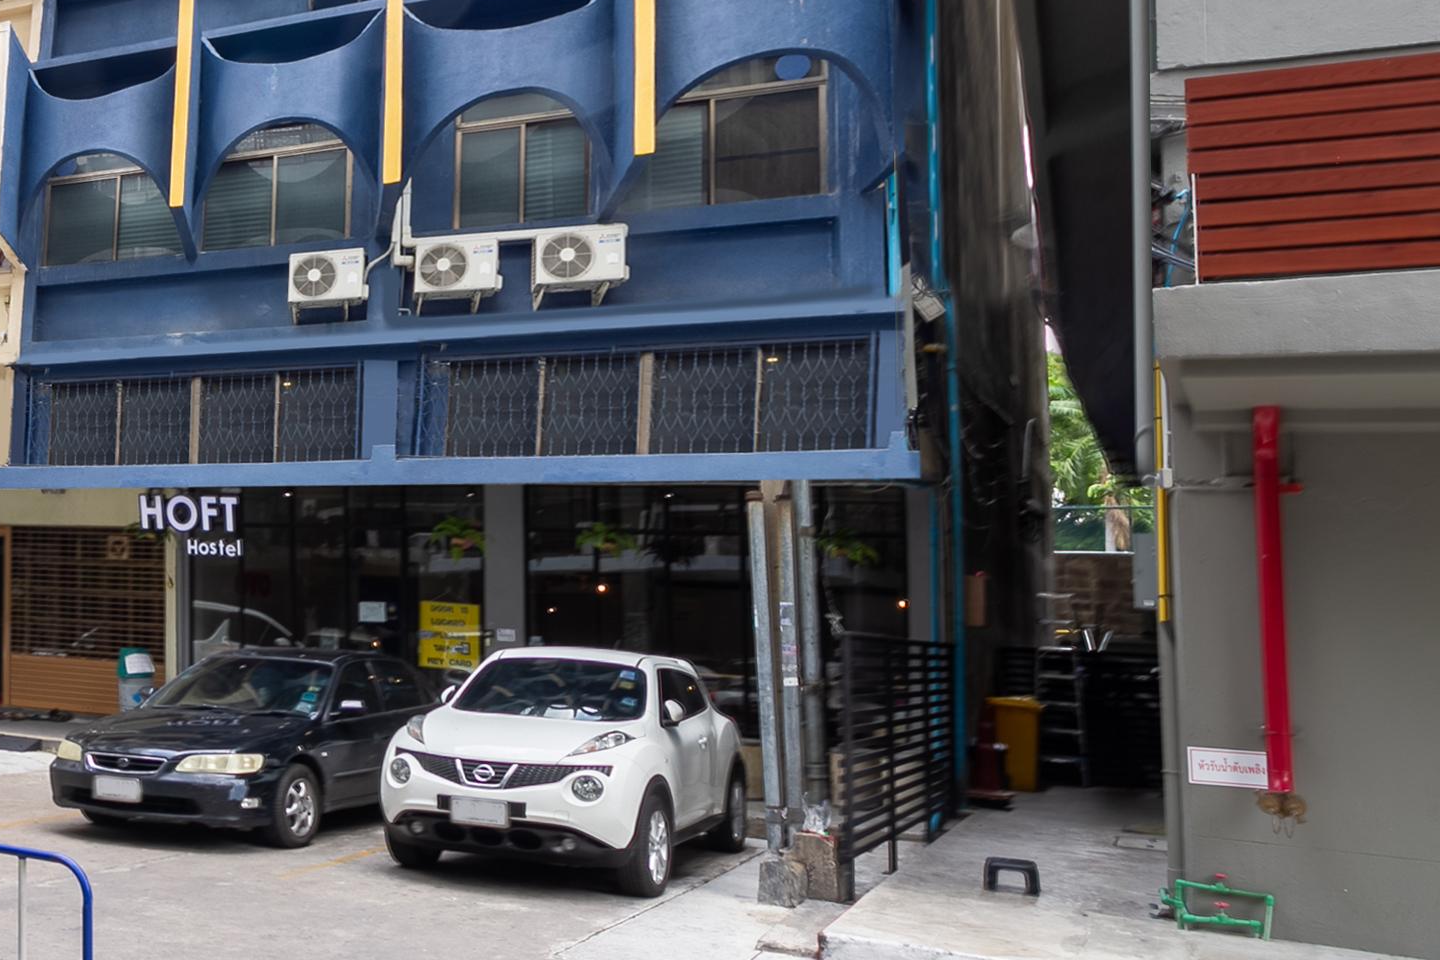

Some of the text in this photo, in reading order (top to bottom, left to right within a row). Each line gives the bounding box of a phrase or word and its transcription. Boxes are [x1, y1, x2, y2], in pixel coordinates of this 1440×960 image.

[140, 495, 238, 532] HOFT
[187, 539, 242, 557] Hostel
[449, 658, 473, 668] CARD
